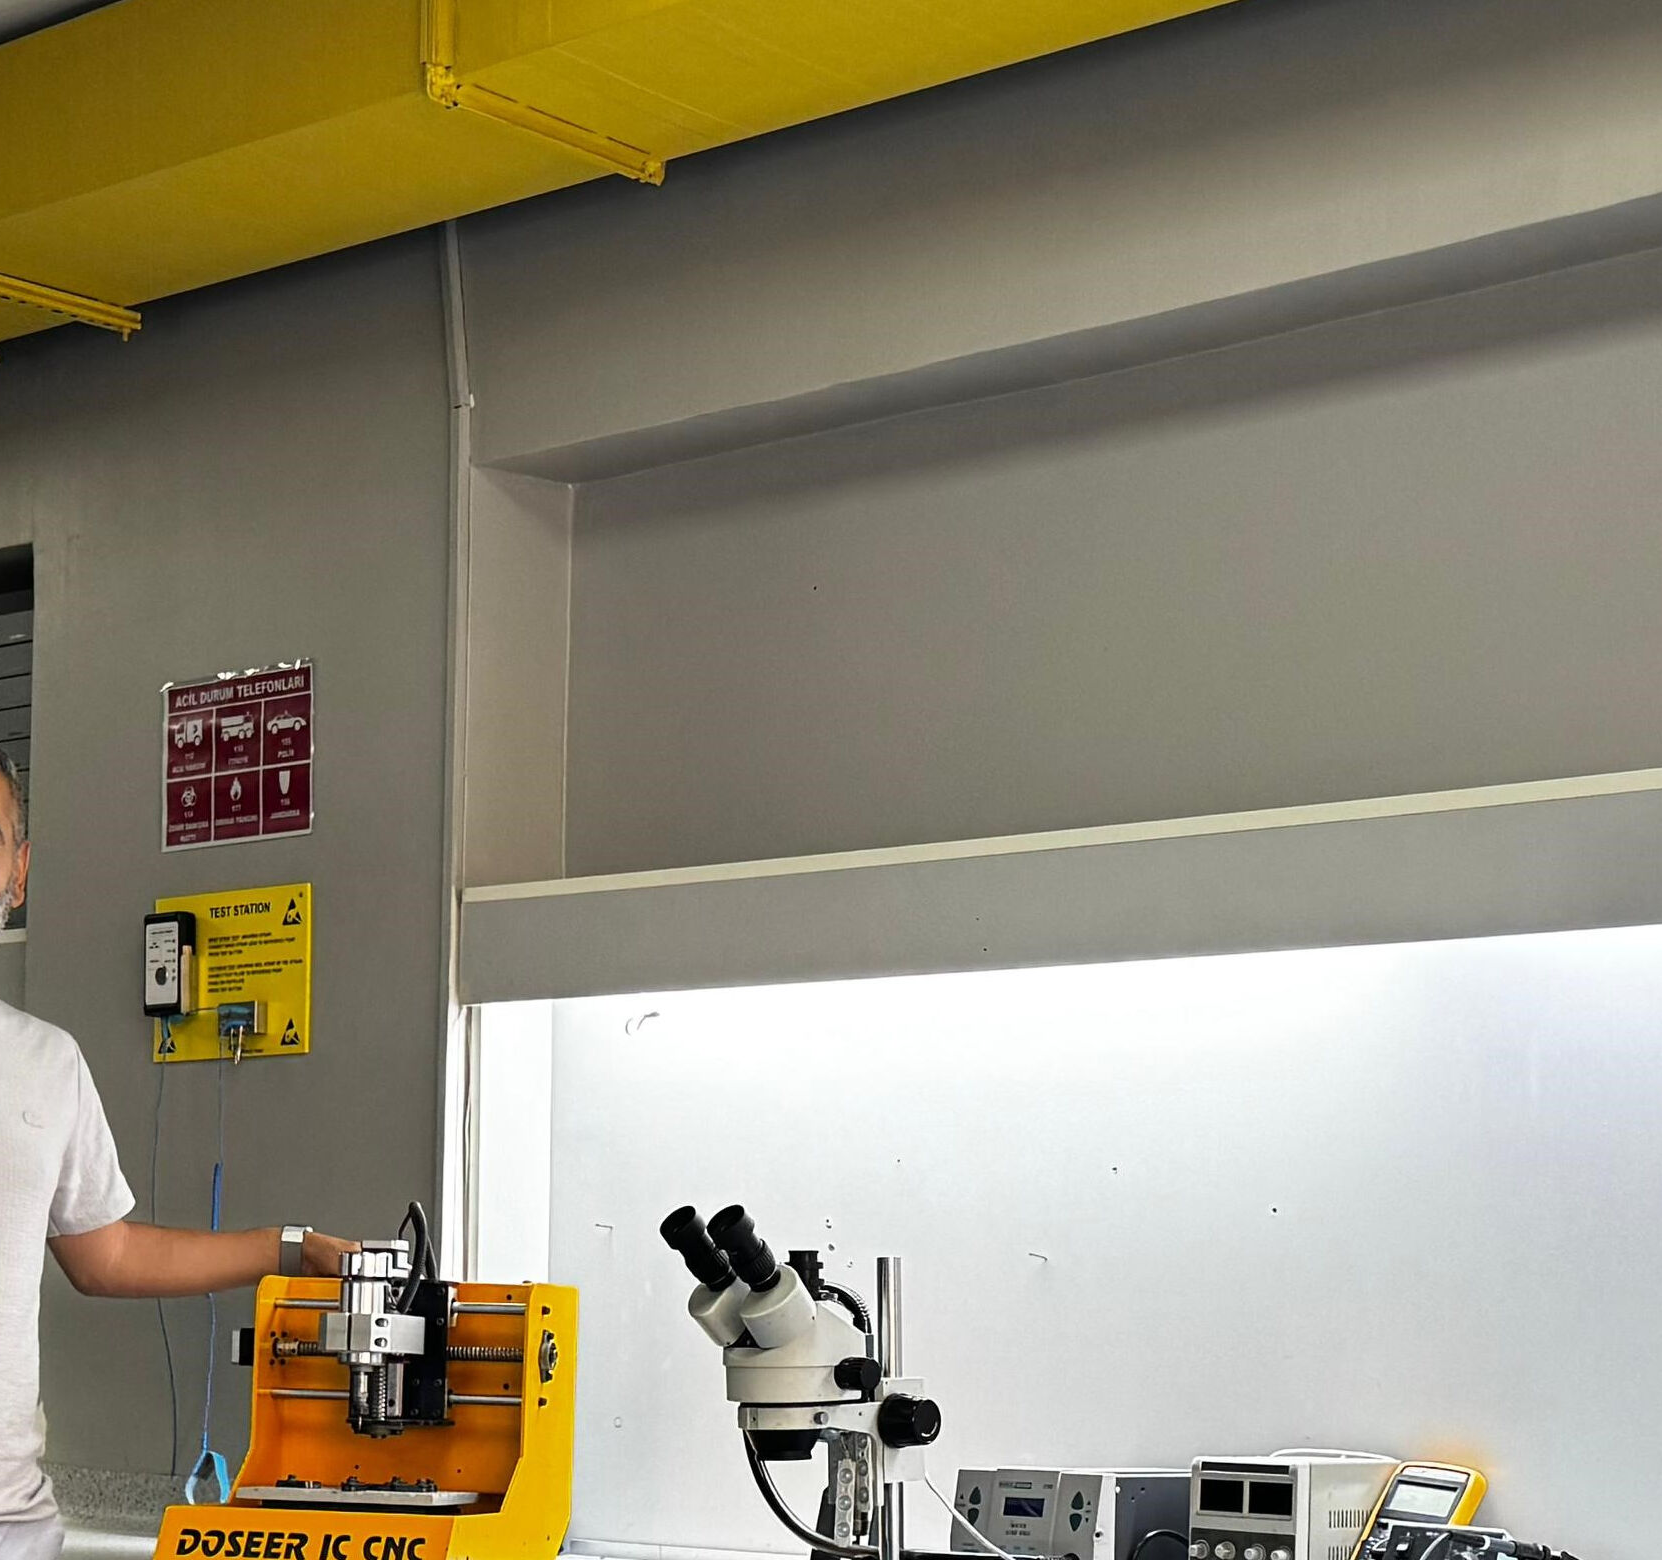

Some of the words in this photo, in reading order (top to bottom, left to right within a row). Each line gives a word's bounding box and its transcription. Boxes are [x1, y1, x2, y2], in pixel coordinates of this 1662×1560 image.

[175, 691, 198, 708] ACİL
[199, 686, 234, 705] DURUM
[237, 675, 304, 698] TELEFONLARI
[209, 906, 231, 919] TEST
[233, 902, 271, 917] STATION
